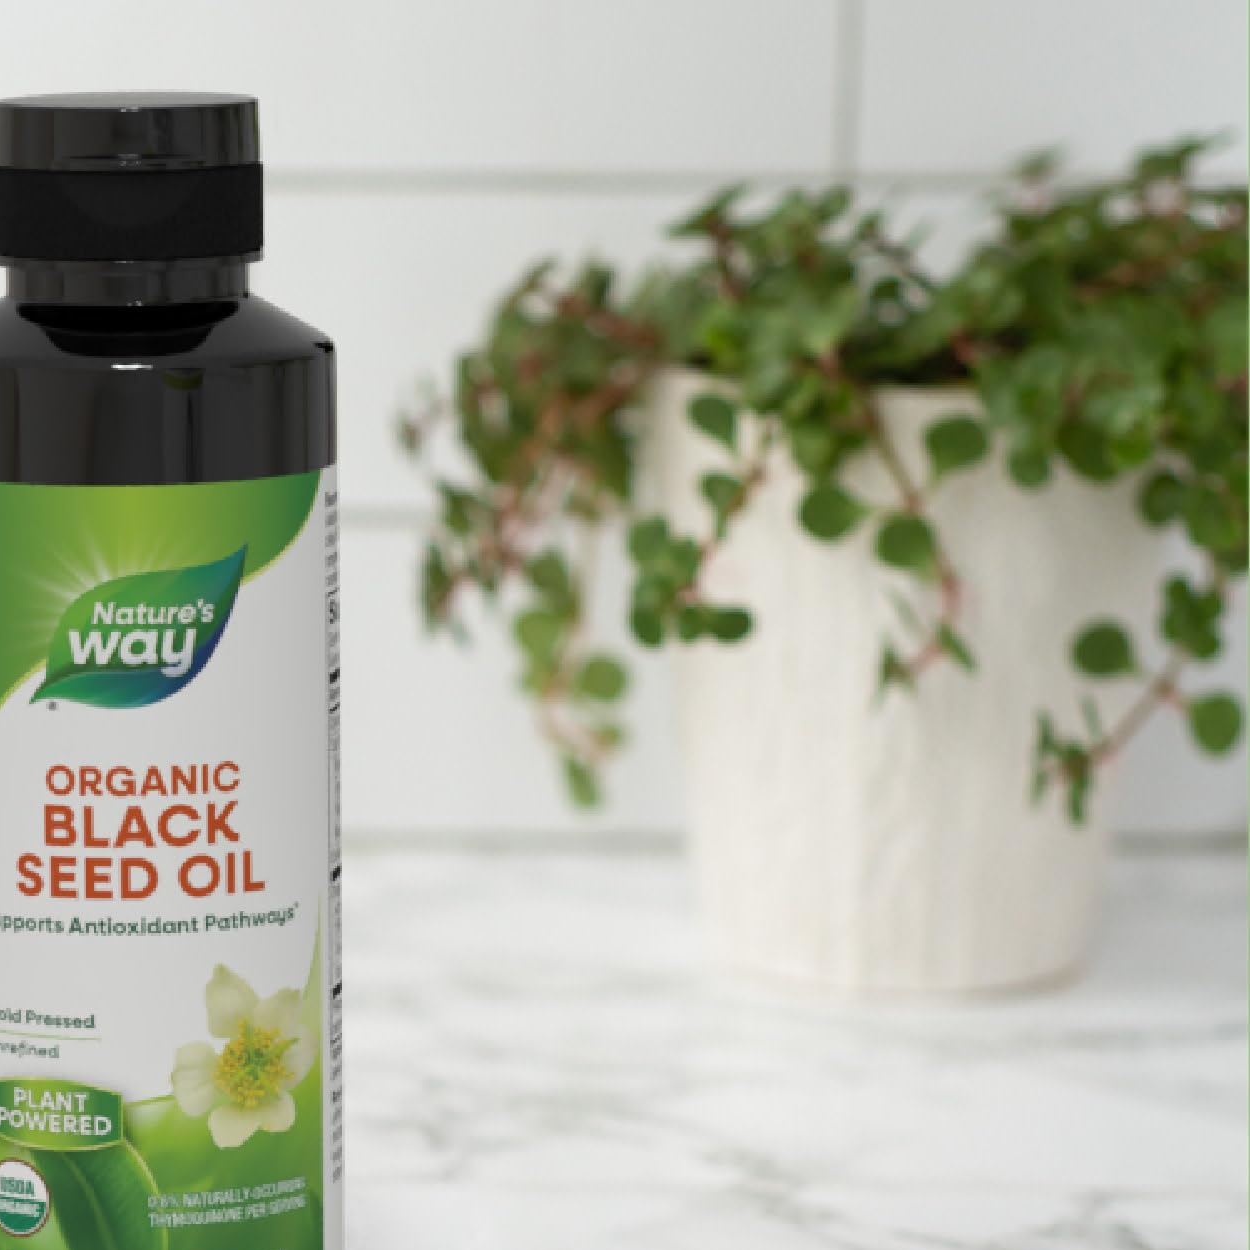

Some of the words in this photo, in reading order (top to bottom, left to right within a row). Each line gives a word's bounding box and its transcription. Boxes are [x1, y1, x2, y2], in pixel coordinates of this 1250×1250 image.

[92, 599, 215, 625] Nature's
[68, 628, 197, 677] way
[46, 760, 241, 797] ORGANIC
[44, 800, 241, 848] BLACK
[16, 852, 159, 900] SEED
[177, 849, 266, 898] OIL
[68, 916, 199, 937] Antioxidant
[25, 1009, 96, 1029] Pressed
[13, 1086, 89, 1113] PLANT
